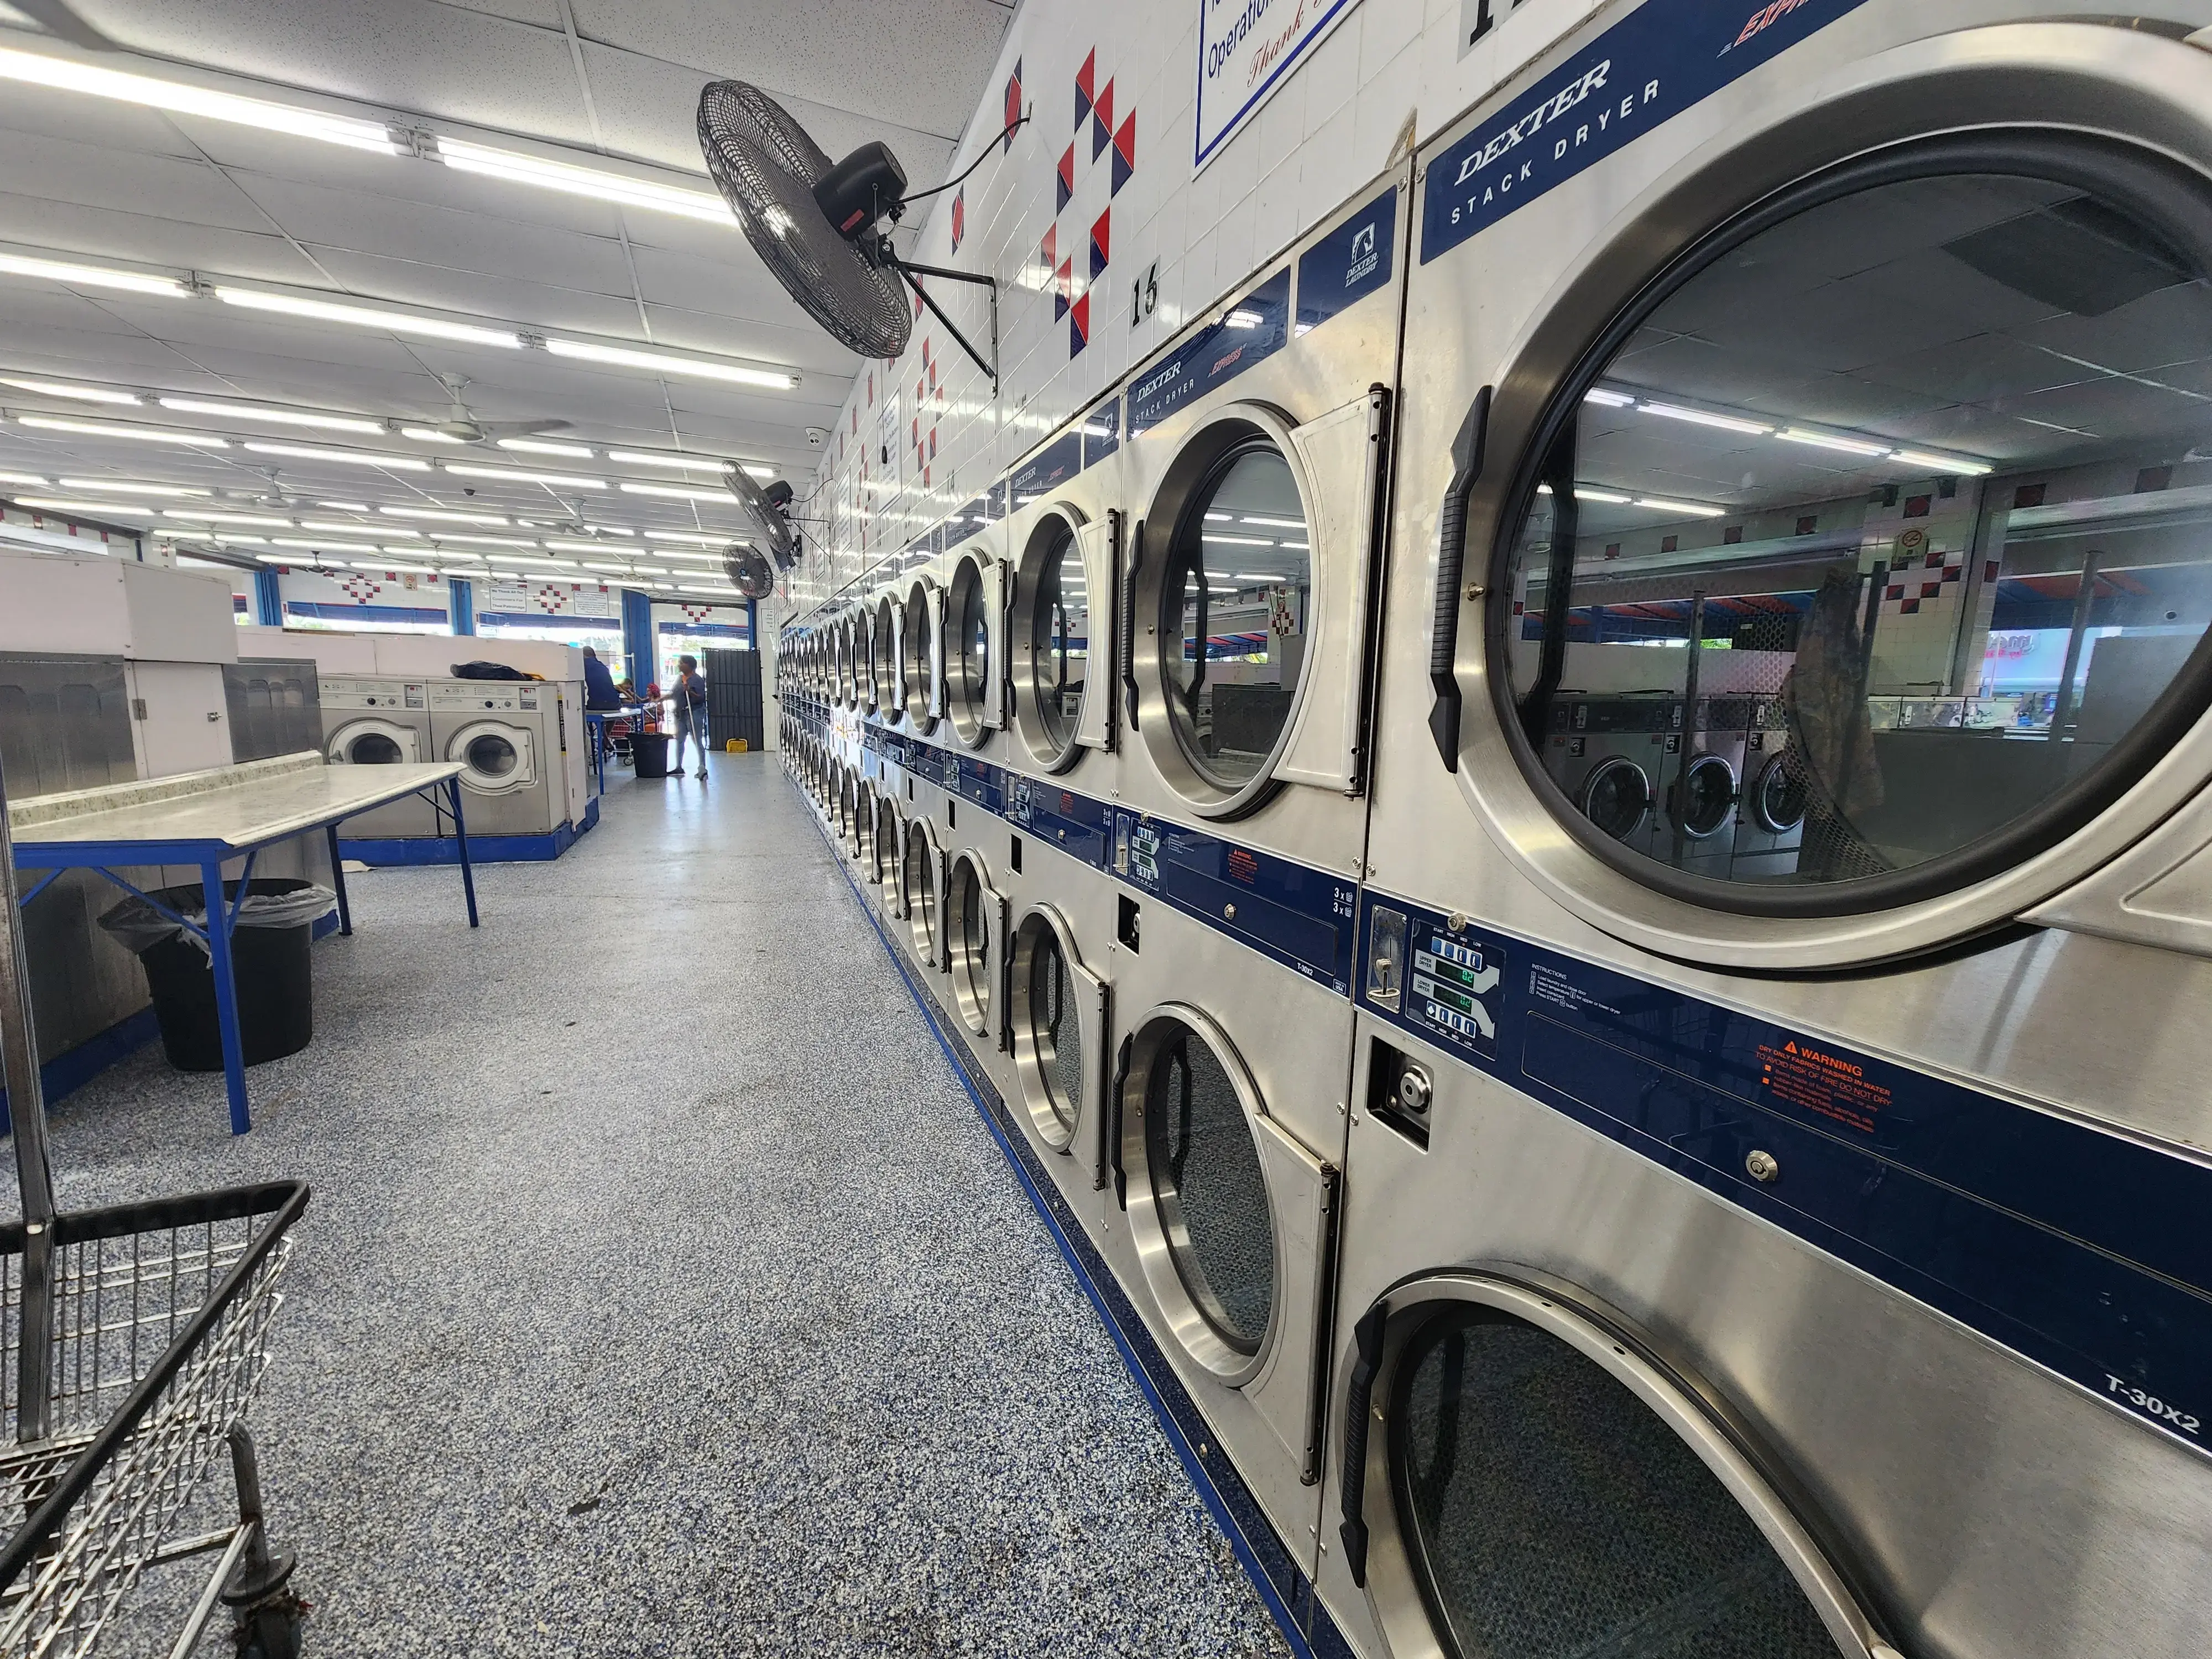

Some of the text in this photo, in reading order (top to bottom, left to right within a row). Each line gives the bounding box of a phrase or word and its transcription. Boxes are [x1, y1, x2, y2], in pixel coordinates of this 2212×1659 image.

[1247, 0, 1304, 87] Thank
[1454, 59, 1611, 186] DEXTER
[1451, 79, 1659, 224] STACK DRYER
[1345, 260, 1378, 288] LAUNDRY
[1132, 262, 1157, 328] 16
[1136, 361, 1181, 403] DEXTER
[1135, 379, 1194, 424] STACK DRYER
[1014, 466, 1036, 489] DEXTER
[1334, 887, 1339, 898] 3
[1333, 902, 1343, 915] 3 x
[1297, 963, 1313, 976] T-30X2
[1419, 960, 1431, 968] DRYER
[1420, 955, 1432, 963] UPPER
[1531, 963, 1567, 980] INSTRUCTIONS
[1547, 978, 1560, 987] laundry
[1417, 979, 1430, 988] LOWER
[1417, 984, 1430, 993] DRYER
[1548, 984, 1569, 995] temperature
[1566, 1003, 1578, 1011] button
[1759, 1045, 1772, 1053] DRY
[1773, 1050, 1791, 1060] ONLY
[1791, 1056, 1821, 1071] FABRICS
[1822, 1067, 1853, 1082] WASHED
[1863, 1082, 1891, 1097] WATER
[1801, 1048, 1863, 1077] WARNING
[1756, 1051, 1766, 1060] TO
[1766, 1056, 1789, 1068] AVOID
[1790, 1064, 1807, 1075] RISK
[1820, 1075, 1838, 1087] FIRE
[1839, 1082, 1853, 1092] DO
[1854, 1088, 1872, 1099] NOT
[2105, 1373, 2200, 1435] T-30X2
